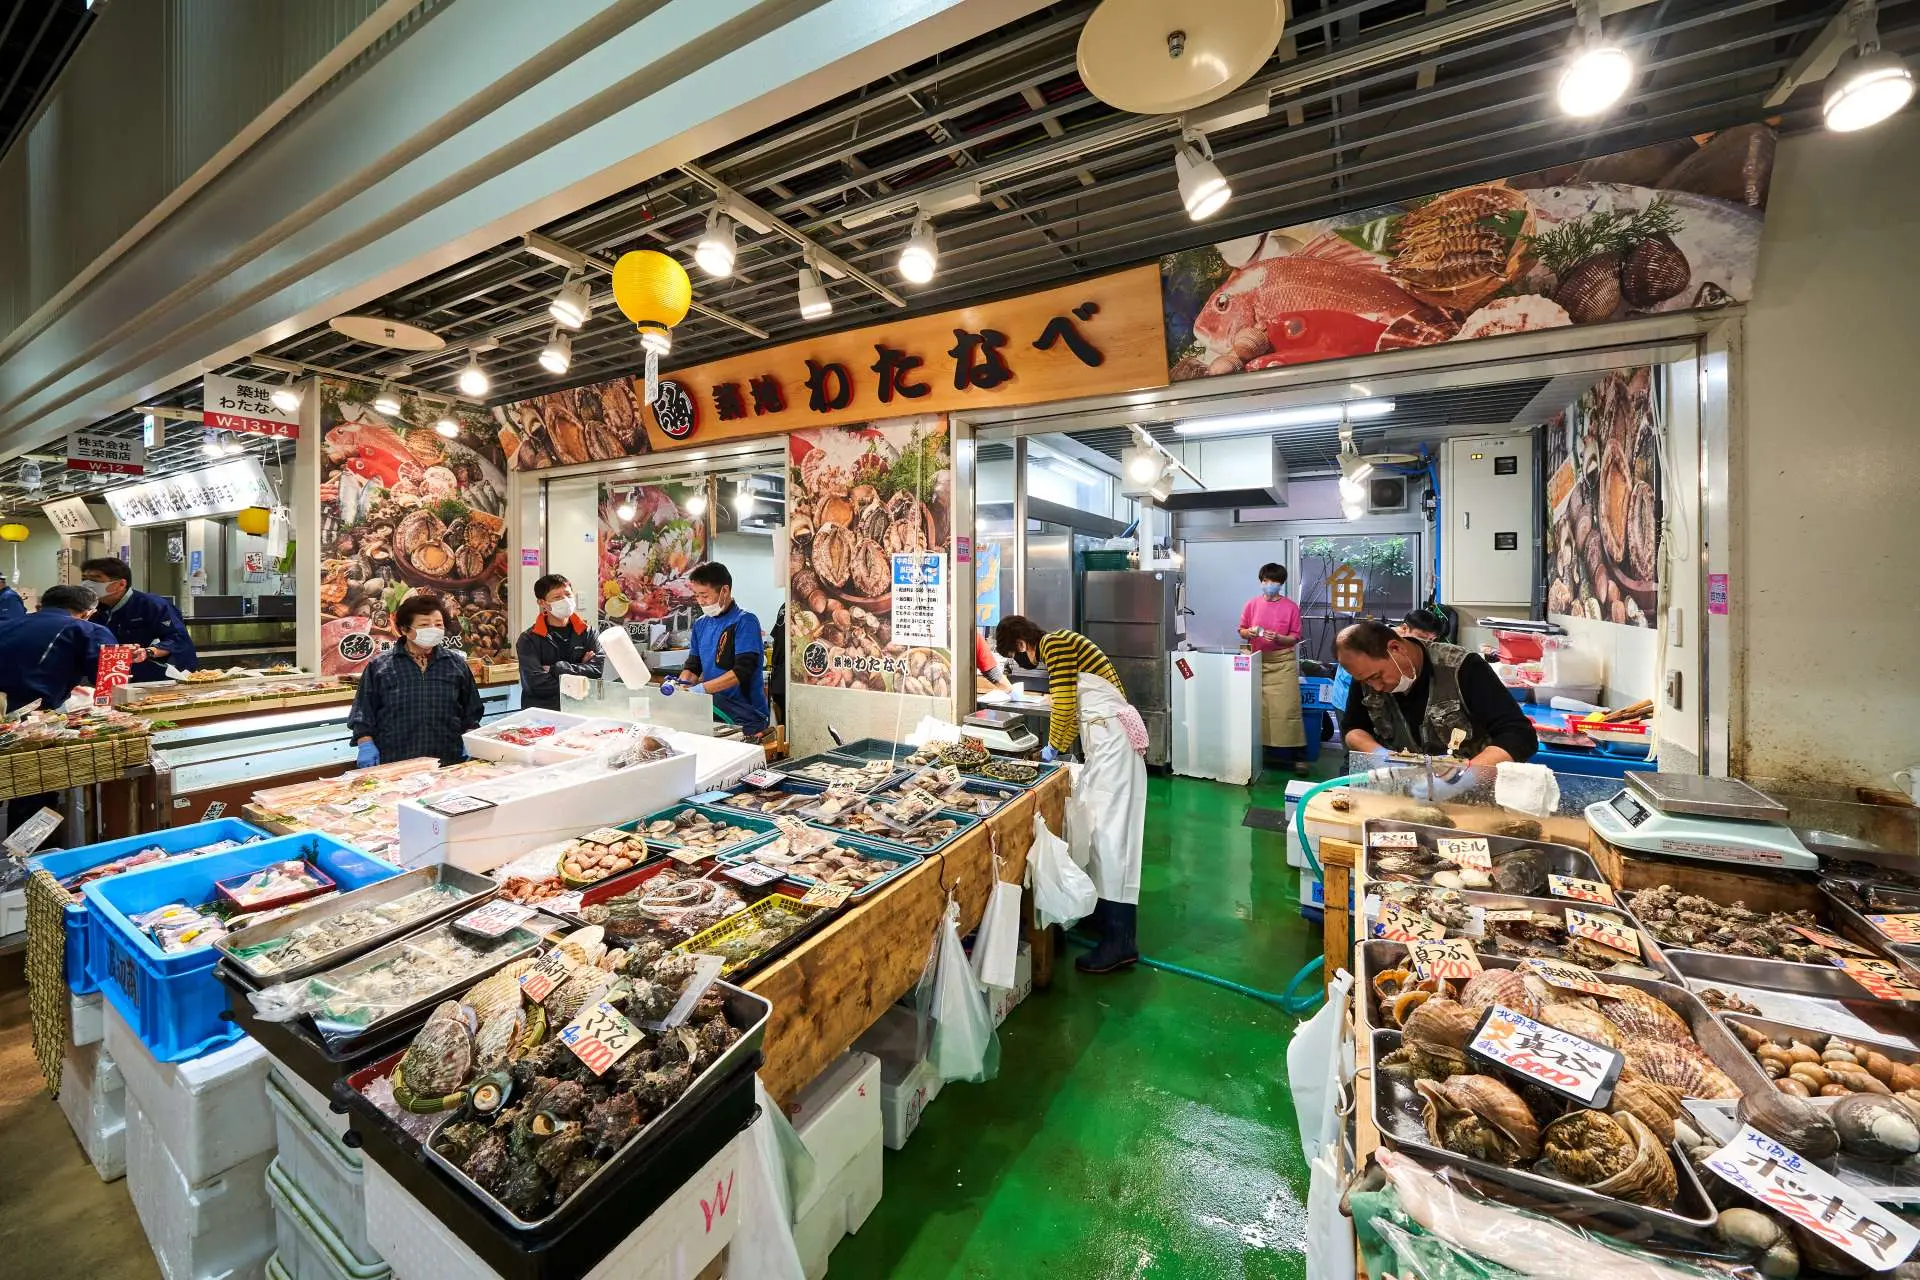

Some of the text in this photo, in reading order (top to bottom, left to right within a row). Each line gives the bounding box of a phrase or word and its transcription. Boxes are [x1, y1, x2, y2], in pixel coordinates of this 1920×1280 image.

[237, 385, 270, 401] 築地
[78, 437, 131, 451] 株式会社
[77, 447, 131, 461] 三栄商店
[88, 461, 125, 473] W-12
